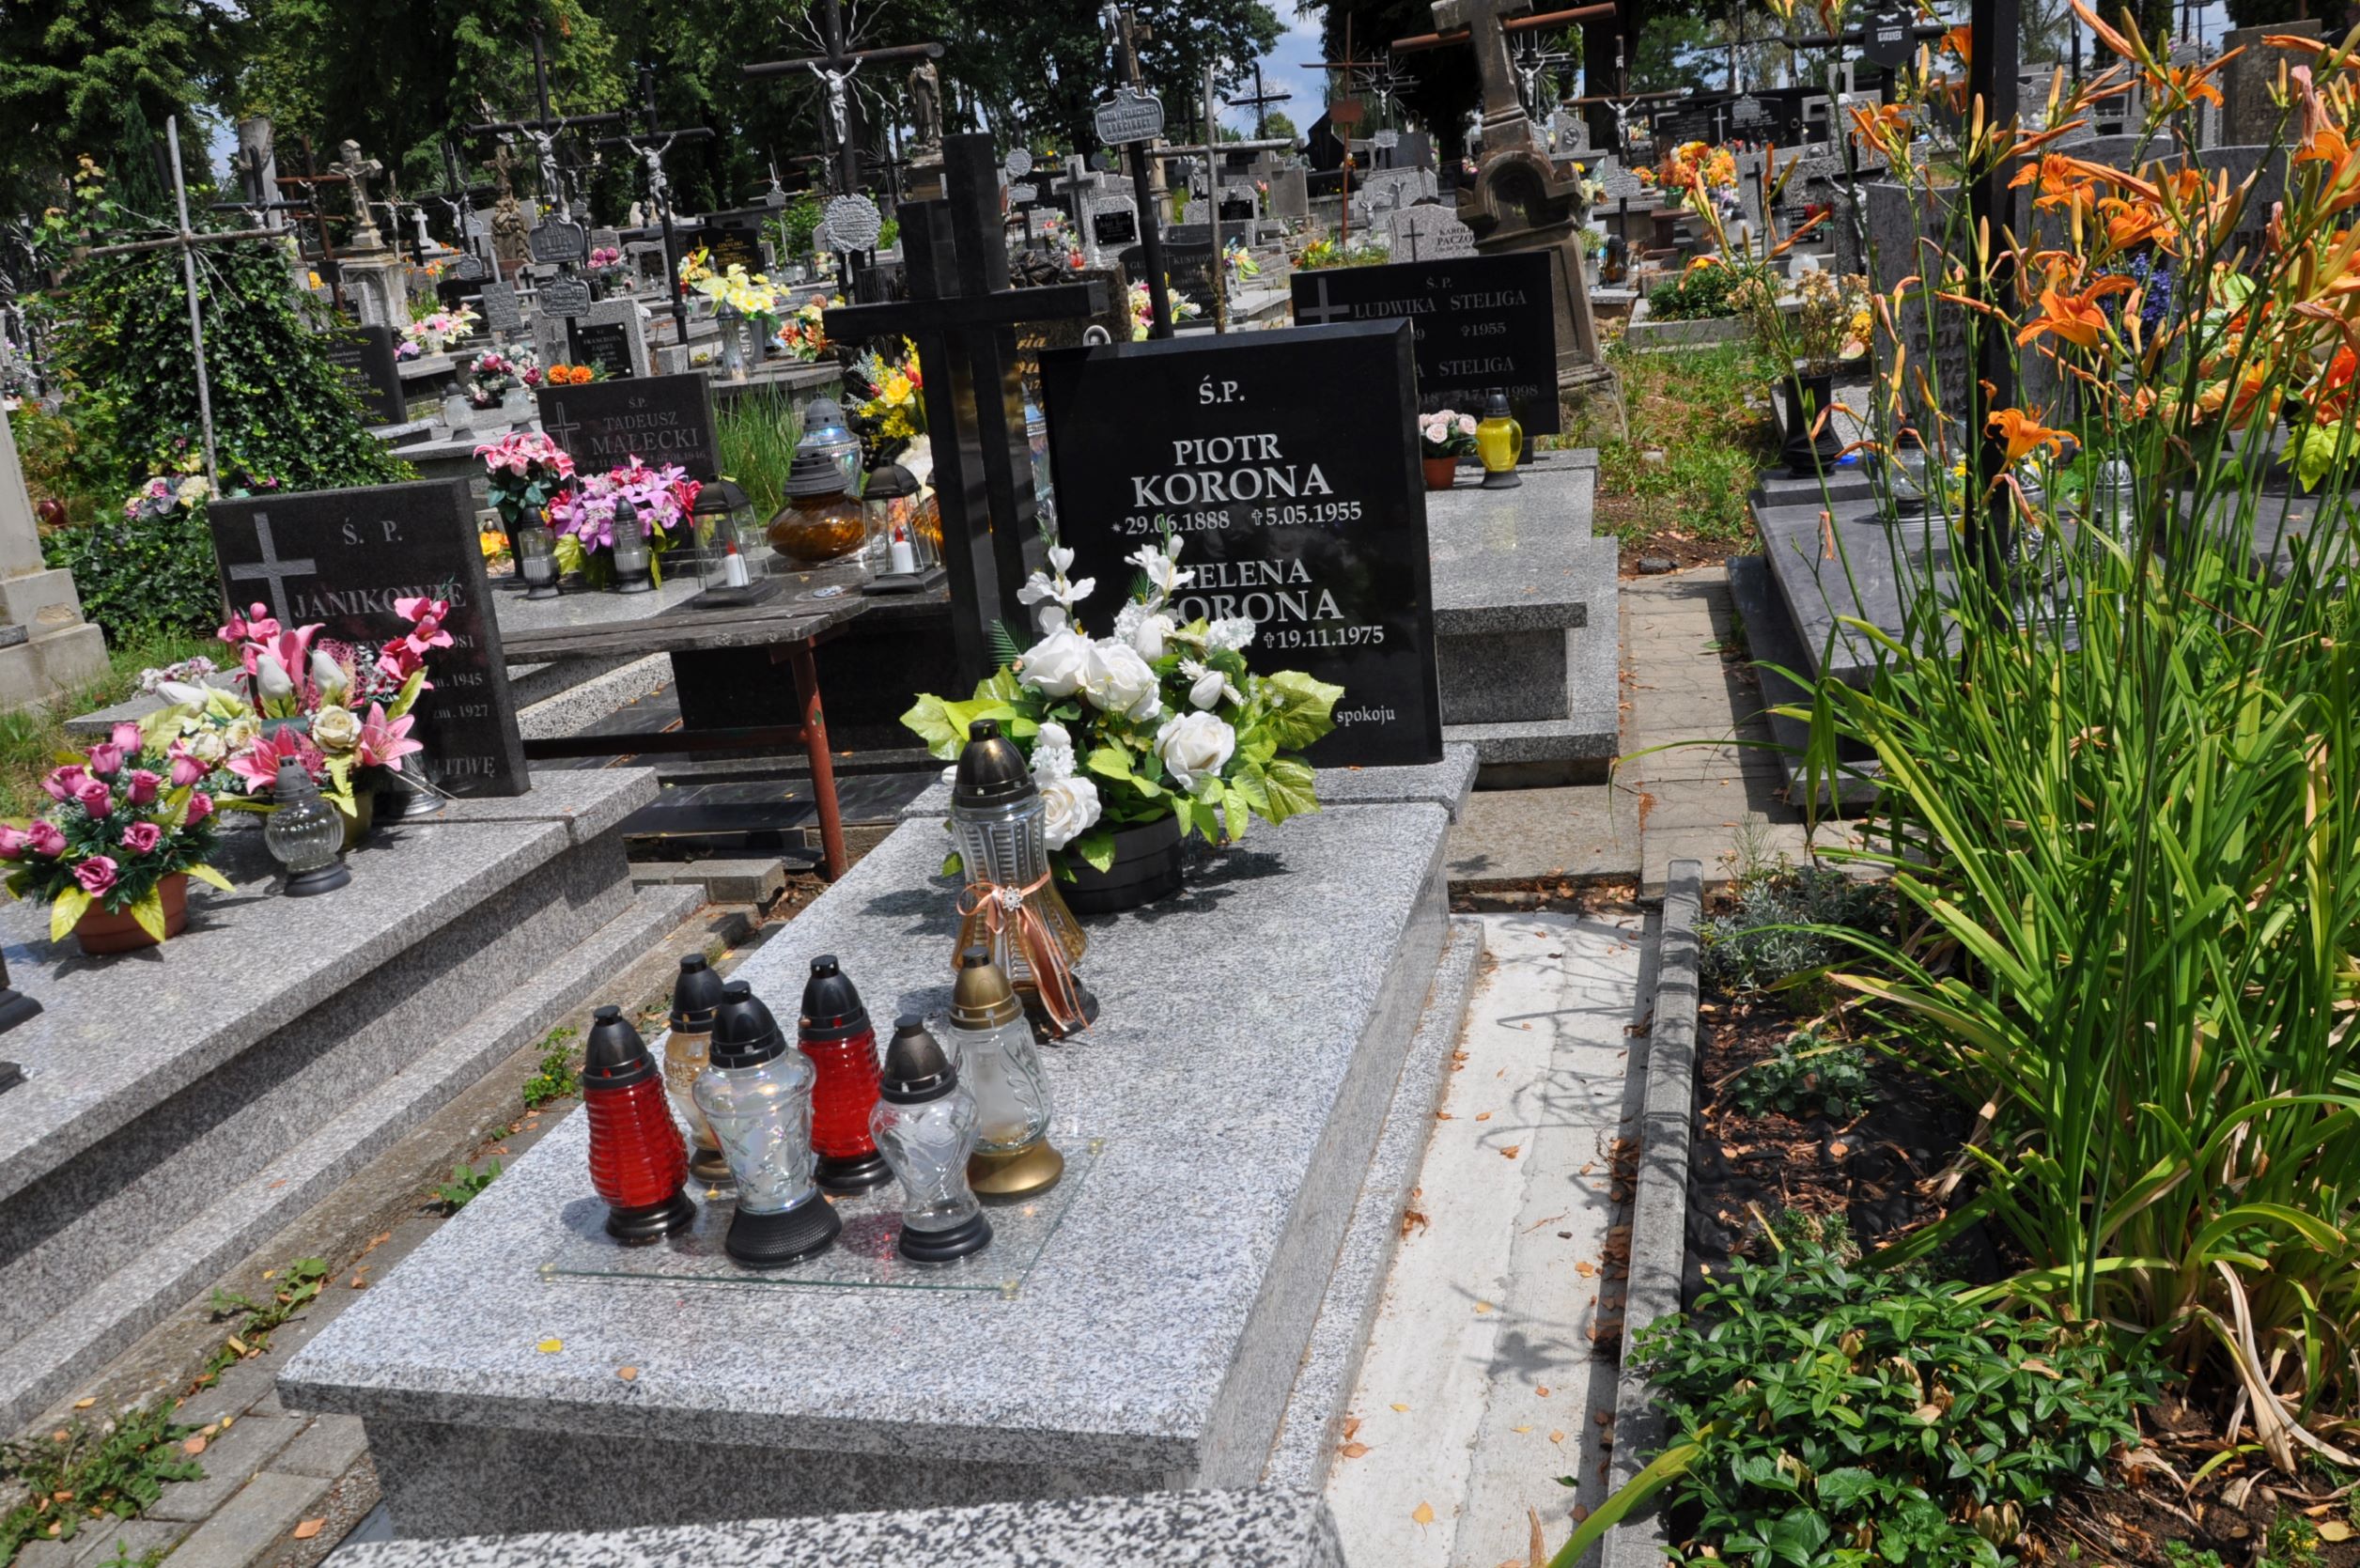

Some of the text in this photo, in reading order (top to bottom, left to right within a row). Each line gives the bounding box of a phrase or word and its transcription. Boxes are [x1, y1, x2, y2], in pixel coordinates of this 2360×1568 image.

[1354, 289, 1528, 319] LUDWIKA STELIGA
[1471, 321, 1507, 336] 1955
[1438, 356, 1515, 377] STELIGA
[1199, 375, 1246, 405] Ś.P.
[603, 411, 678, 431] TADEUSZ
[591, 428, 700, 456] MAŁECKI
[1172, 433, 1283, 467] PIOTR
[1130, 463, 1334, 508] KORONA
[1265, 502, 1362, 526] 5.05.1955
[1171, 588, 1344, 628] ORONA
[1276, 626, 1385, 649] 19.11.1975
[458, 704, 489, 719] 1927
[1336, 706, 1396, 728] spokoju
